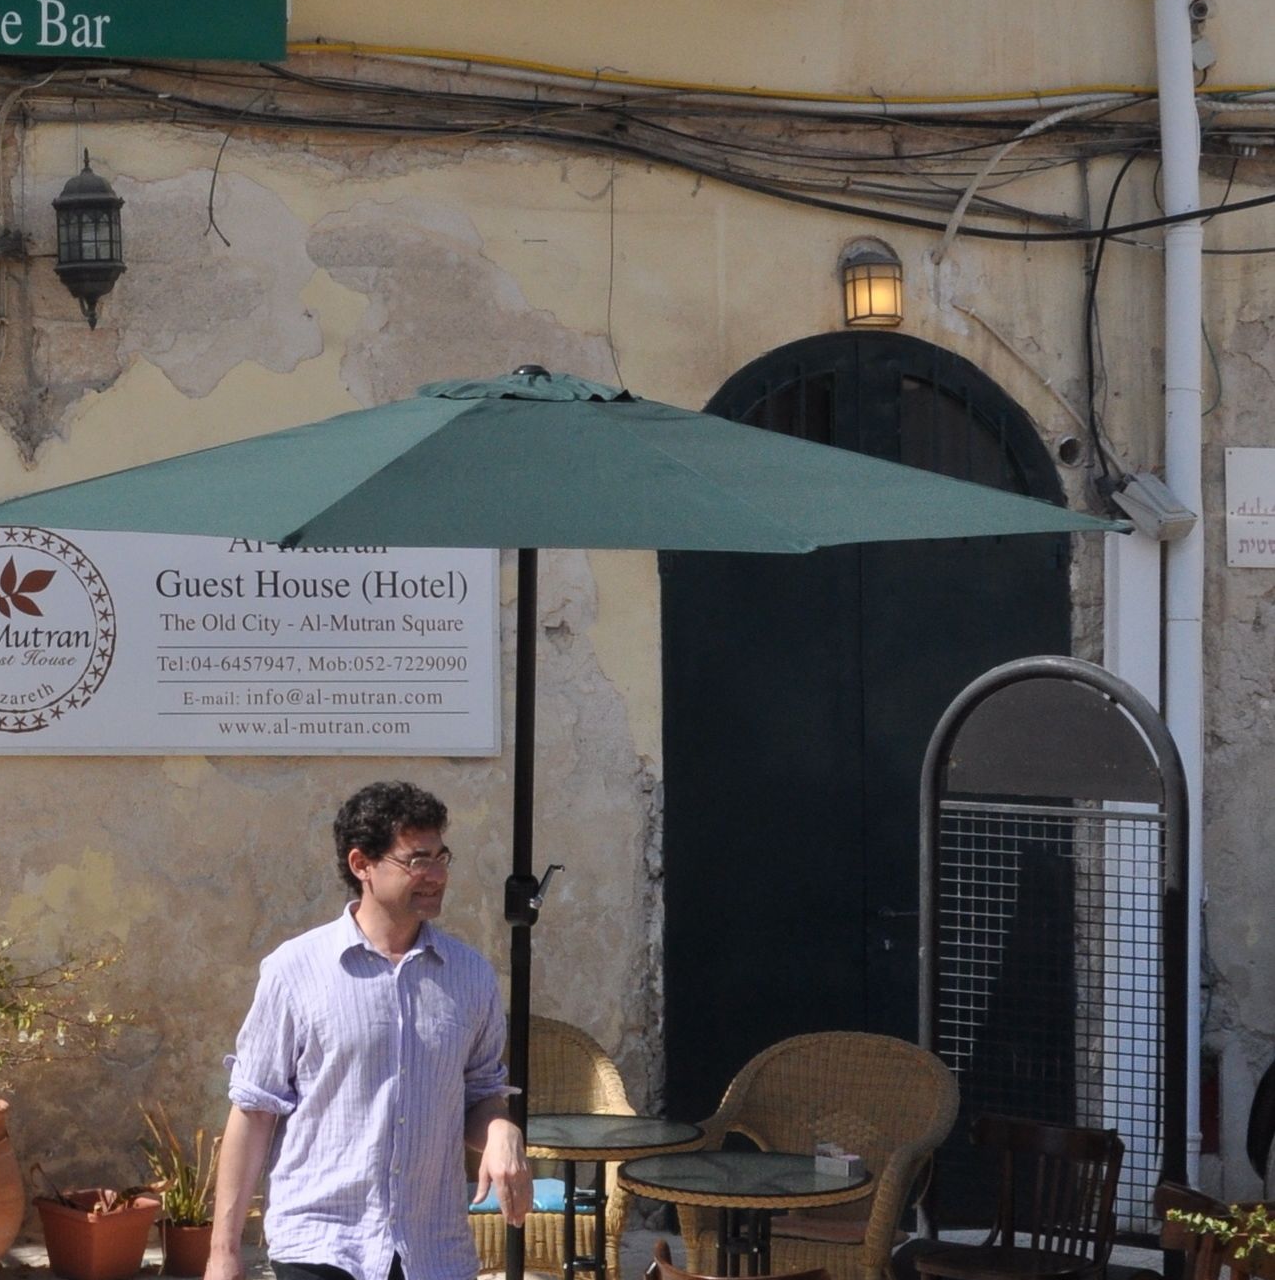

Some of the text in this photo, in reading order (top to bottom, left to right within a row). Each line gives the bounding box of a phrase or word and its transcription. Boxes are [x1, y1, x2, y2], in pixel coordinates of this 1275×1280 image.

[155, 569, 468, 605] Guest House (Hotel)
[160, 613, 196, 631] The
[201, 613, 235, 632] Old
[242, 613, 281, 635] City
[299, 613, 396, 632] Al-Mutran
[401, 614, 464, 636] Square
[21, 649, 77, 666] House
[157, 656, 468, 673] Tel:04-6457947, Mob:052-7229090
[183, 688, 444, 706] E-mail: info@al-mutran.com
[218, 718, 412, 735] www.al-mutran.com
